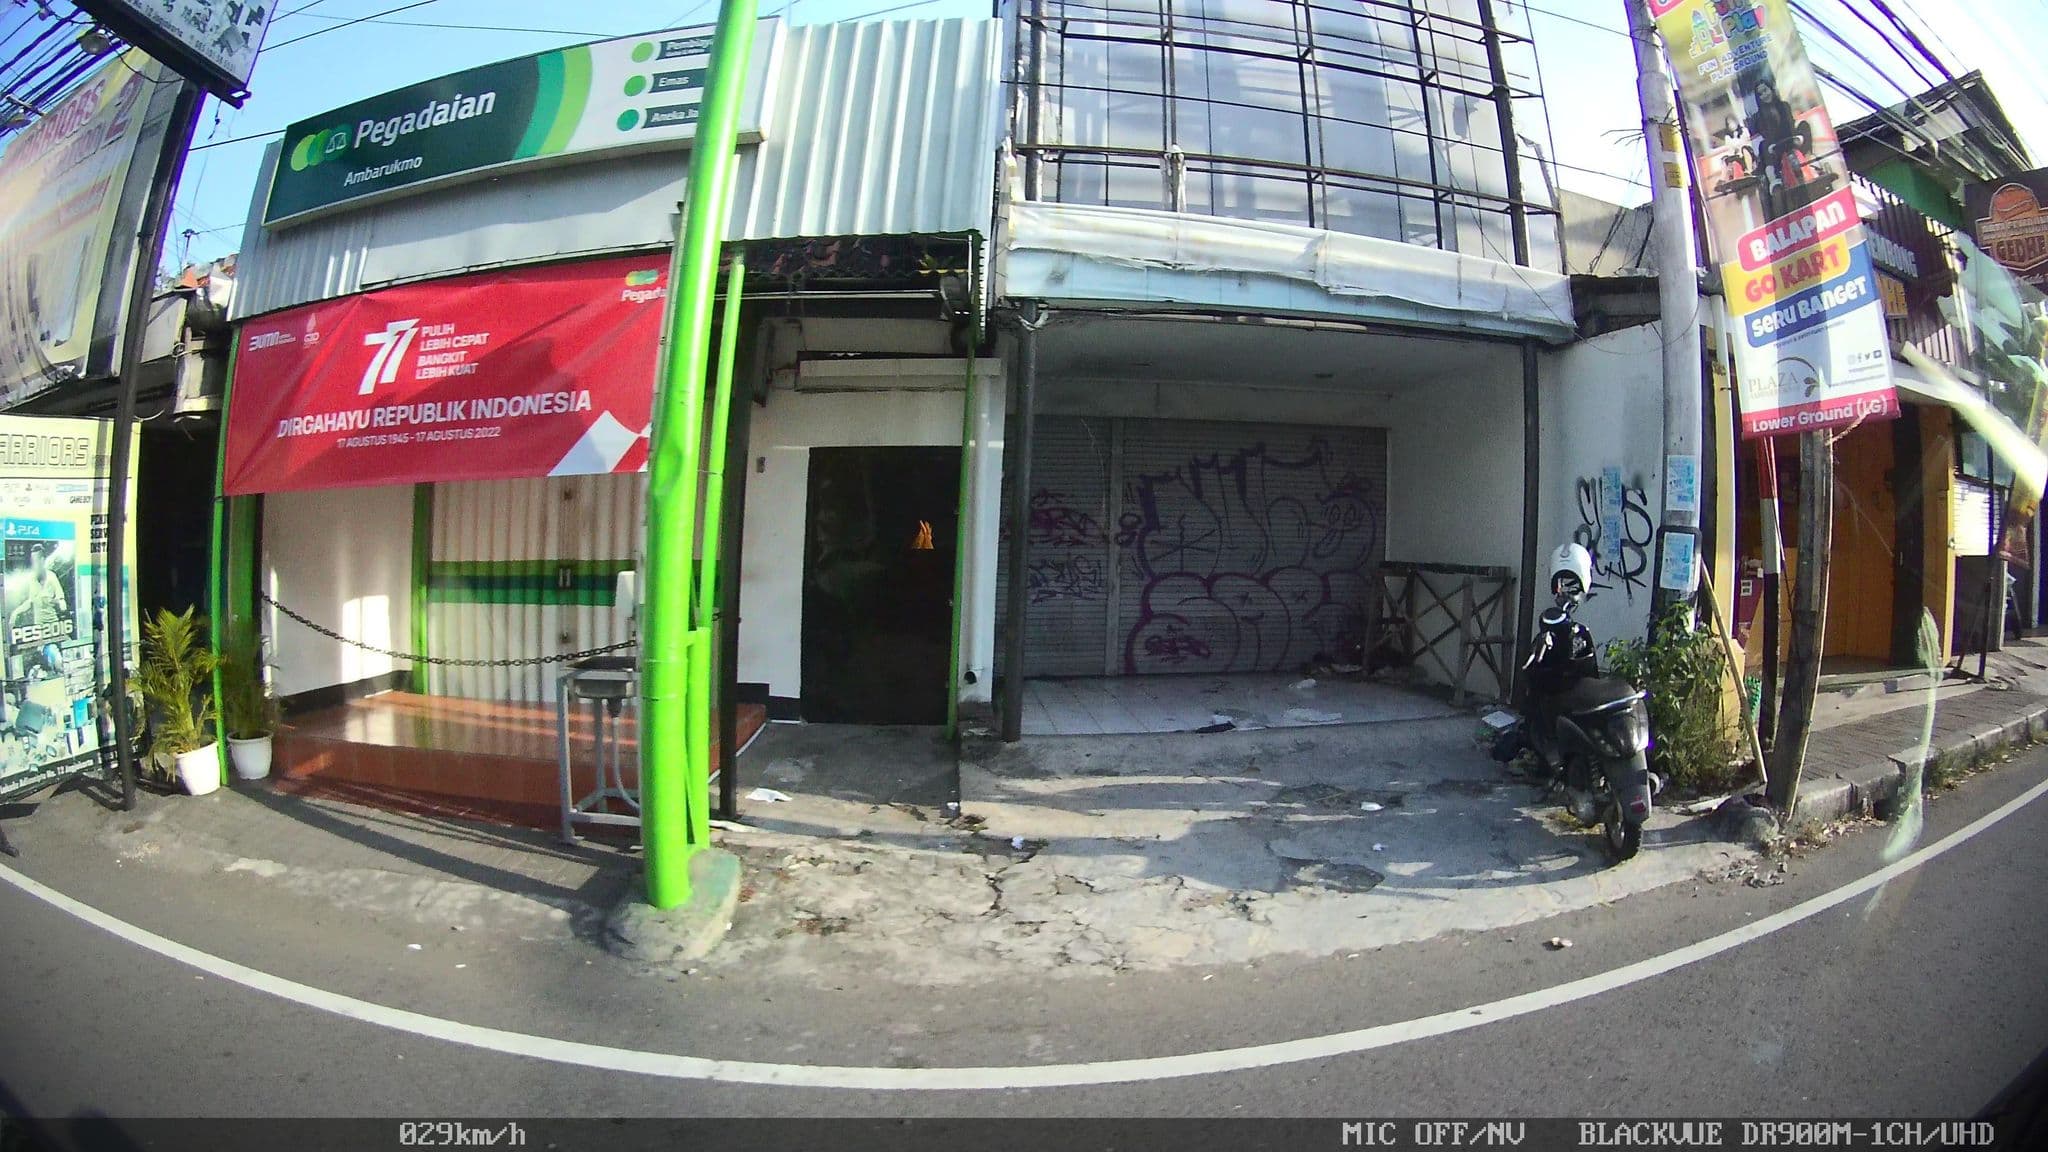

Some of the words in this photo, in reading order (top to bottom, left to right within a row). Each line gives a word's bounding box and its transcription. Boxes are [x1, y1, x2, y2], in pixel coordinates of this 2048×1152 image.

[1699, 59, 1718, 75] FUN
[1722, 34, 1773, 63] ADVENTURE
[659, 76, 690, 87] Emas
[354, 92, 496, 148] Pegadaian
[344, 156, 423, 187] Ambarukmo
[1745, 273, 1777, 303] GO
[1779, 242, 1841, 290] KART
[420, 337, 452, 352] LEBIH
[452, 332, 490, 348] CEPAT
[421, 323, 455, 337] PULIH
[358, 318, 421, 395] 77
[417, 350, 469, 367] BANGKIT
[415, 366, 448, 380] LEBIH
[448, 362, 480, 377] KUAT
[277, 408, 371, 438] DIRGAHAYU
[372, 399, 467, 428] REPUBLIK
[470, 389, 593, 420] INDONESIA
[1752, 415, 1796, 433] Lower
[1798, 402, 1853, 425] Ground
[1856, 394, 1888, 418] (LG)
[346, 433, 387, 448] AGUSTUS
[388, 432, 410, 445] 1945
[416, 431, 426, 443] 17
[427, 427, 474, 443] AGUSTUS
[475, 425, 501, 438] 2022
[17, 525, 40, 536] PS4
[12, 620, 73, 645] PES2016
